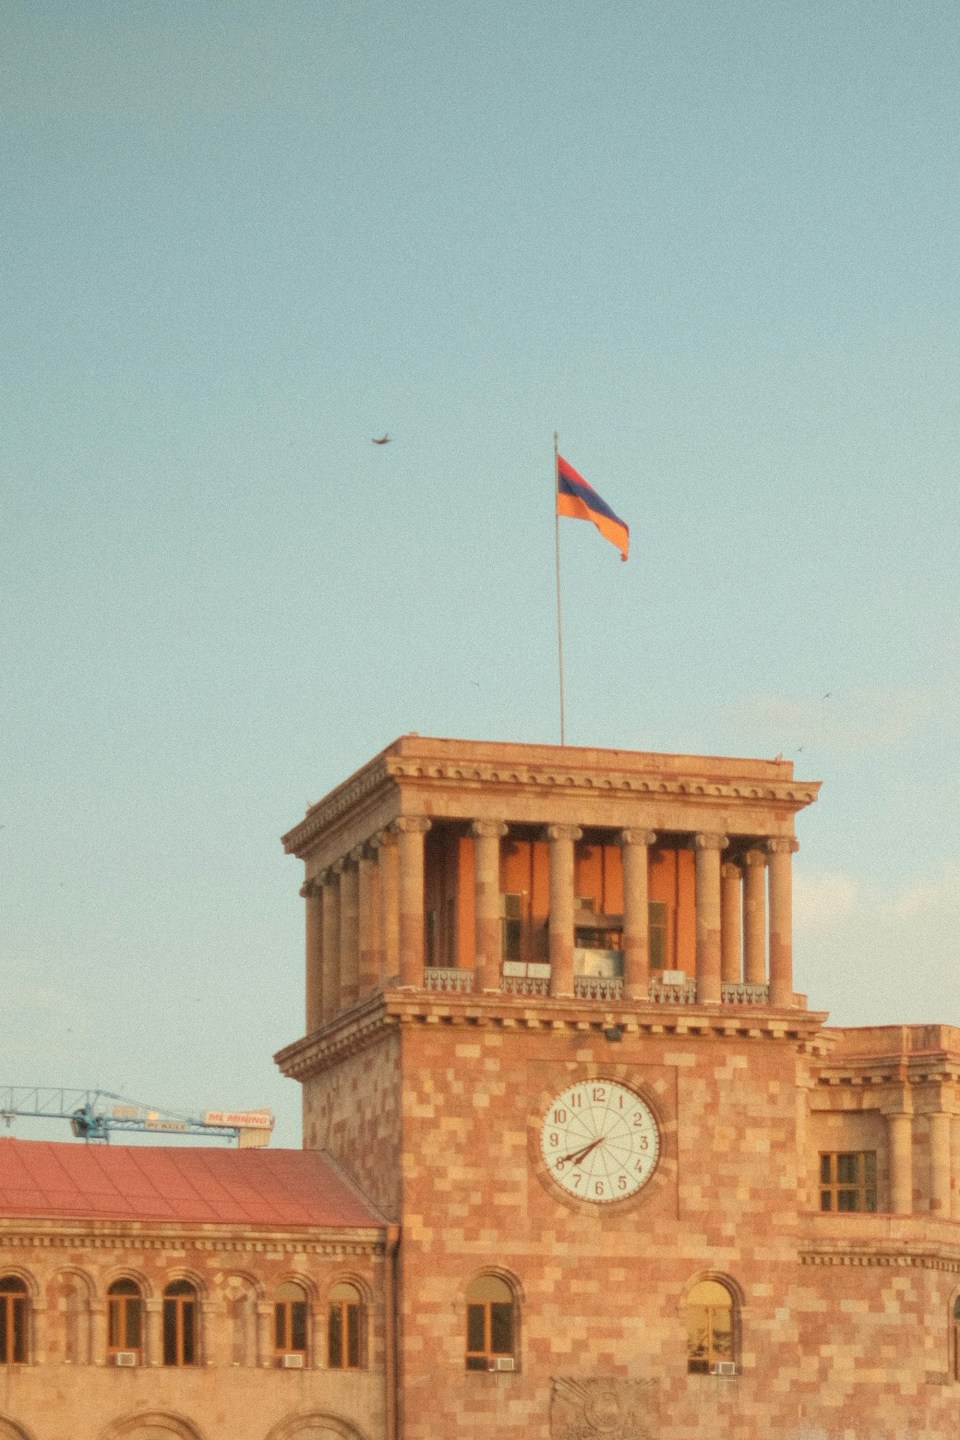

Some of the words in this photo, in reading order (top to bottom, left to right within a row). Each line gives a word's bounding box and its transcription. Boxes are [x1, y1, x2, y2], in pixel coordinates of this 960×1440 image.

[572, 1093, 581, 1107] 11
[593, 1088, 606, 1102] 12
[619, 1095, 623, 1109] 1
[554, 1109, 566, 1124] 10
[633, 1112, 642, 1126] 2
[550, 1133, 559, 1147] 9
[640, 1136, 648, 1150] 3
[556, 1156, 565, 1170] 8
[634, 1159, 642, 1173] 4
[573, 1174, 582, 1188] 7
[595, 1181, 604, 1195] 6
[618, 1176, 627, 1190] 5
